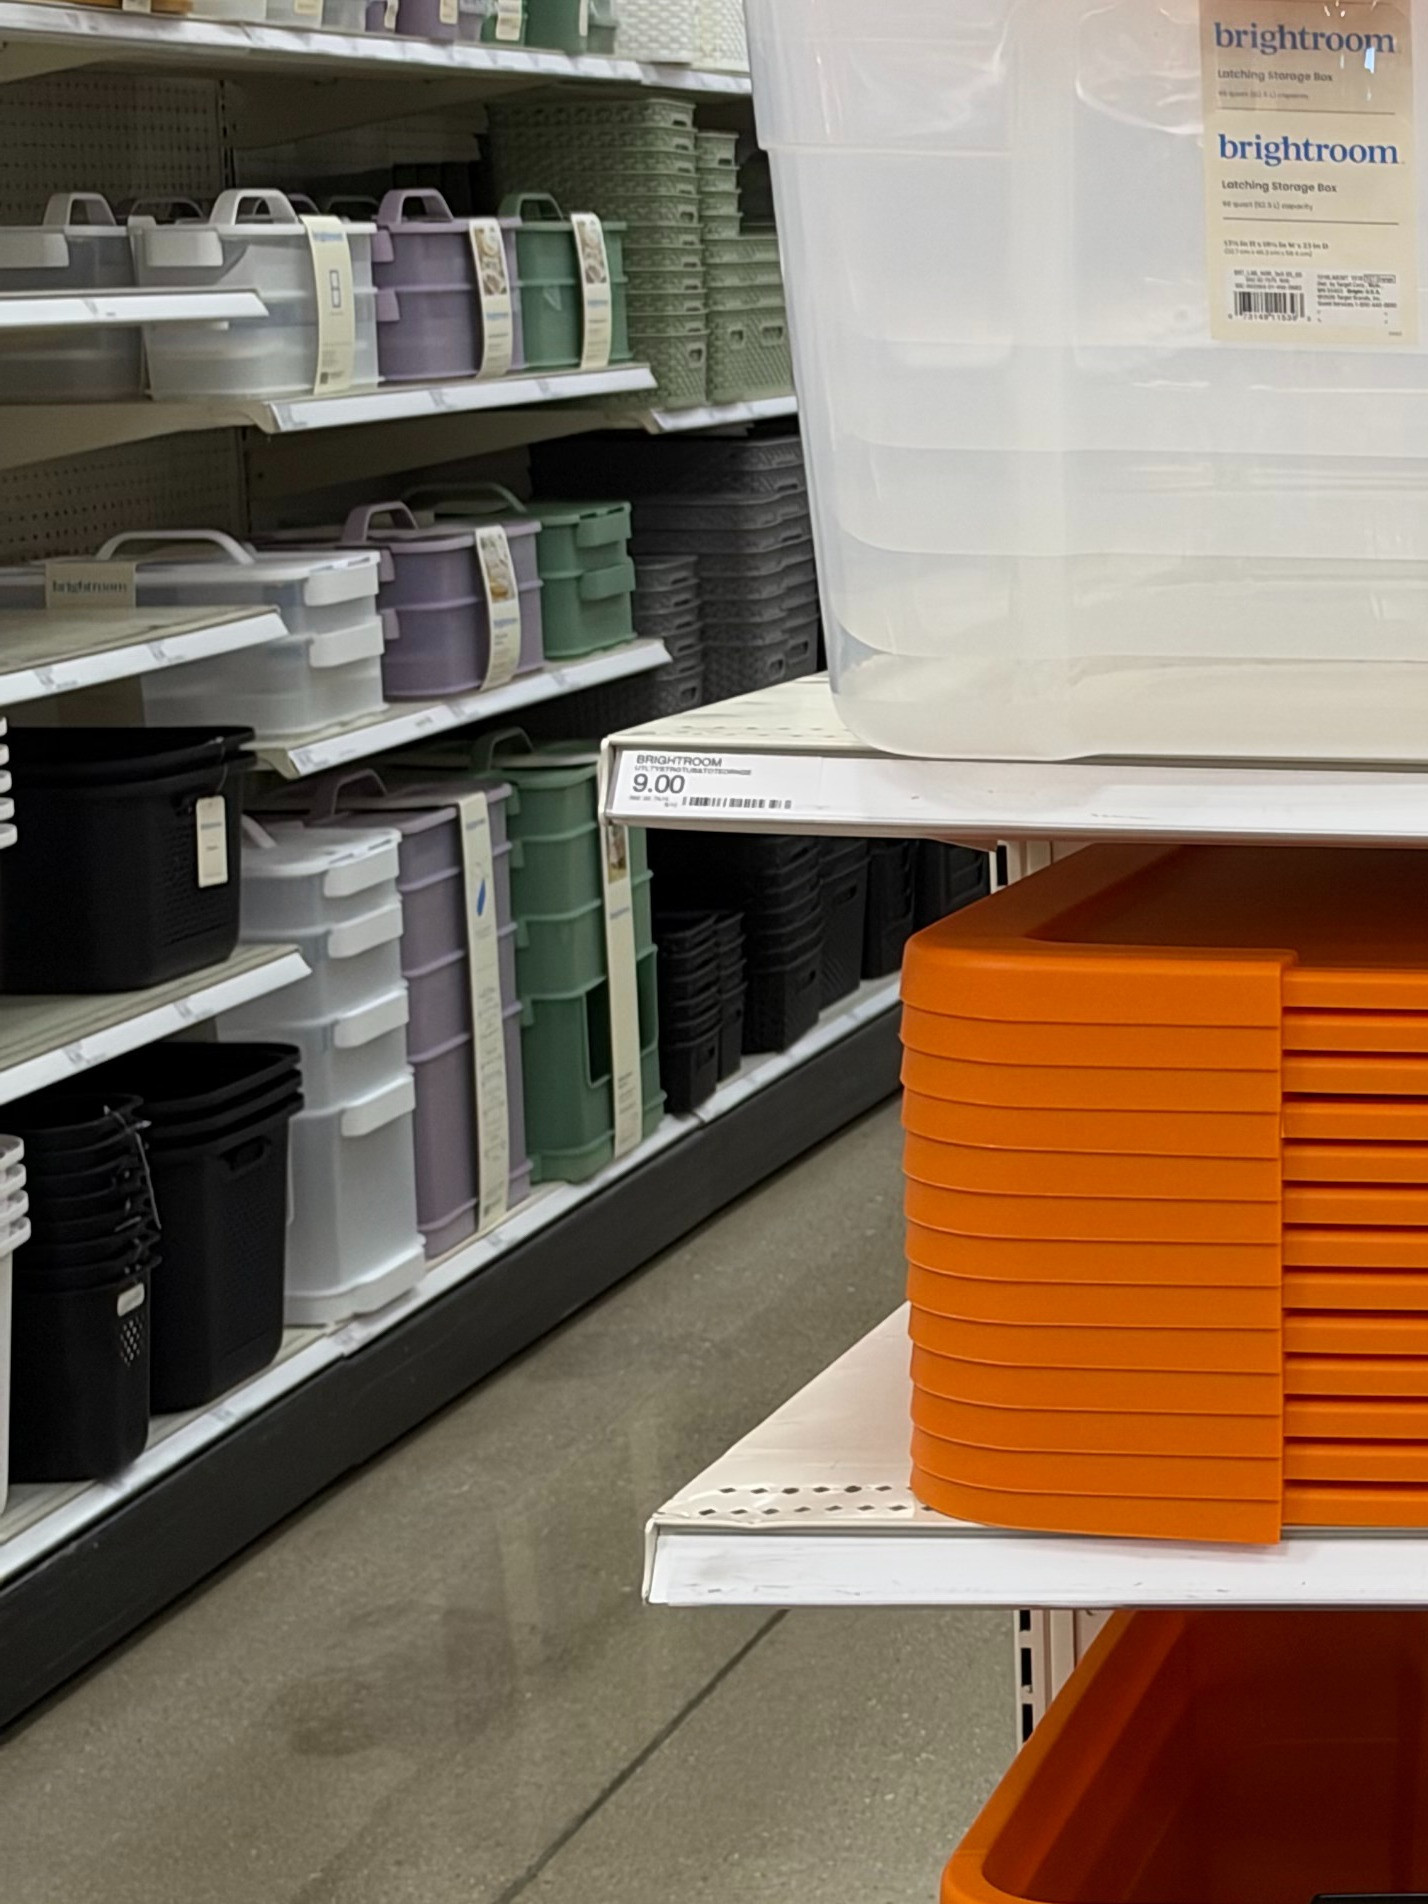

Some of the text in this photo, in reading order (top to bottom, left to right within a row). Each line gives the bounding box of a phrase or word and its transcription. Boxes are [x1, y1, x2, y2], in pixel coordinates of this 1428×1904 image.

[1214, 22, 1396, 56] brightroom
[1217, 69, 1333, 83] Latching Storage Box
[1218, 133, 1399, 167] brightroom
[1221, 180, 1337, 195] Latching Storage Box
[636, 754, 722, 767] BRIGHTROOM
[632, 773, 685, 794] 9.00
